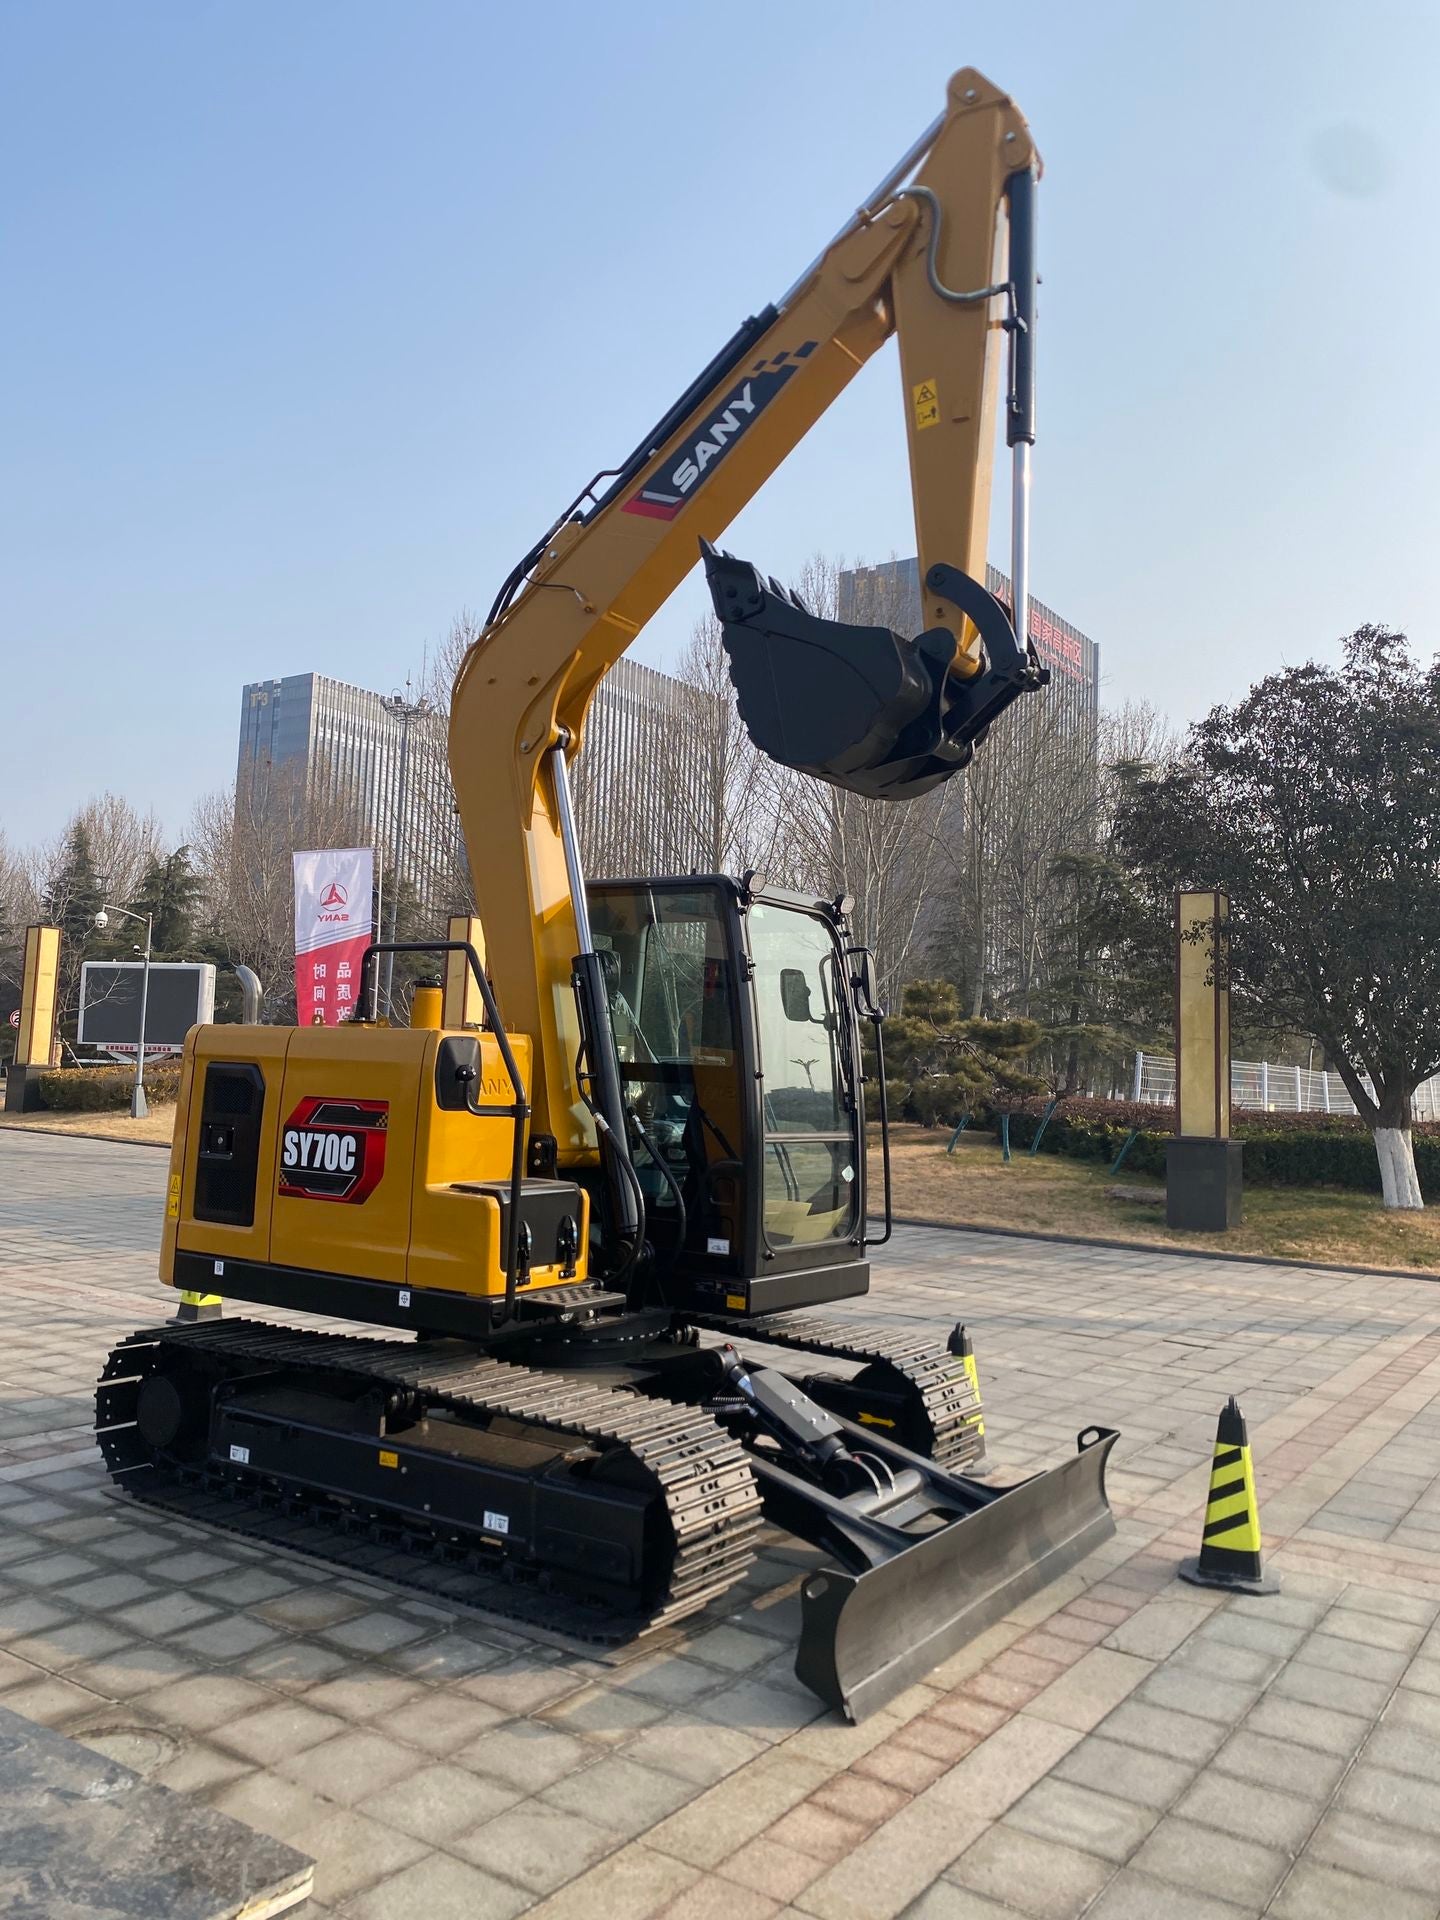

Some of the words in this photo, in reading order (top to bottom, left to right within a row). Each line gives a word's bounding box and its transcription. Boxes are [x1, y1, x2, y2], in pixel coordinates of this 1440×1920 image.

[672, 382, 755, 494] SANY
[1030, 608, 1081, 668] 国家高新区
[480, 1078, 512, 1095] ANY
[283, 1130, 357, 1172] SY70C
